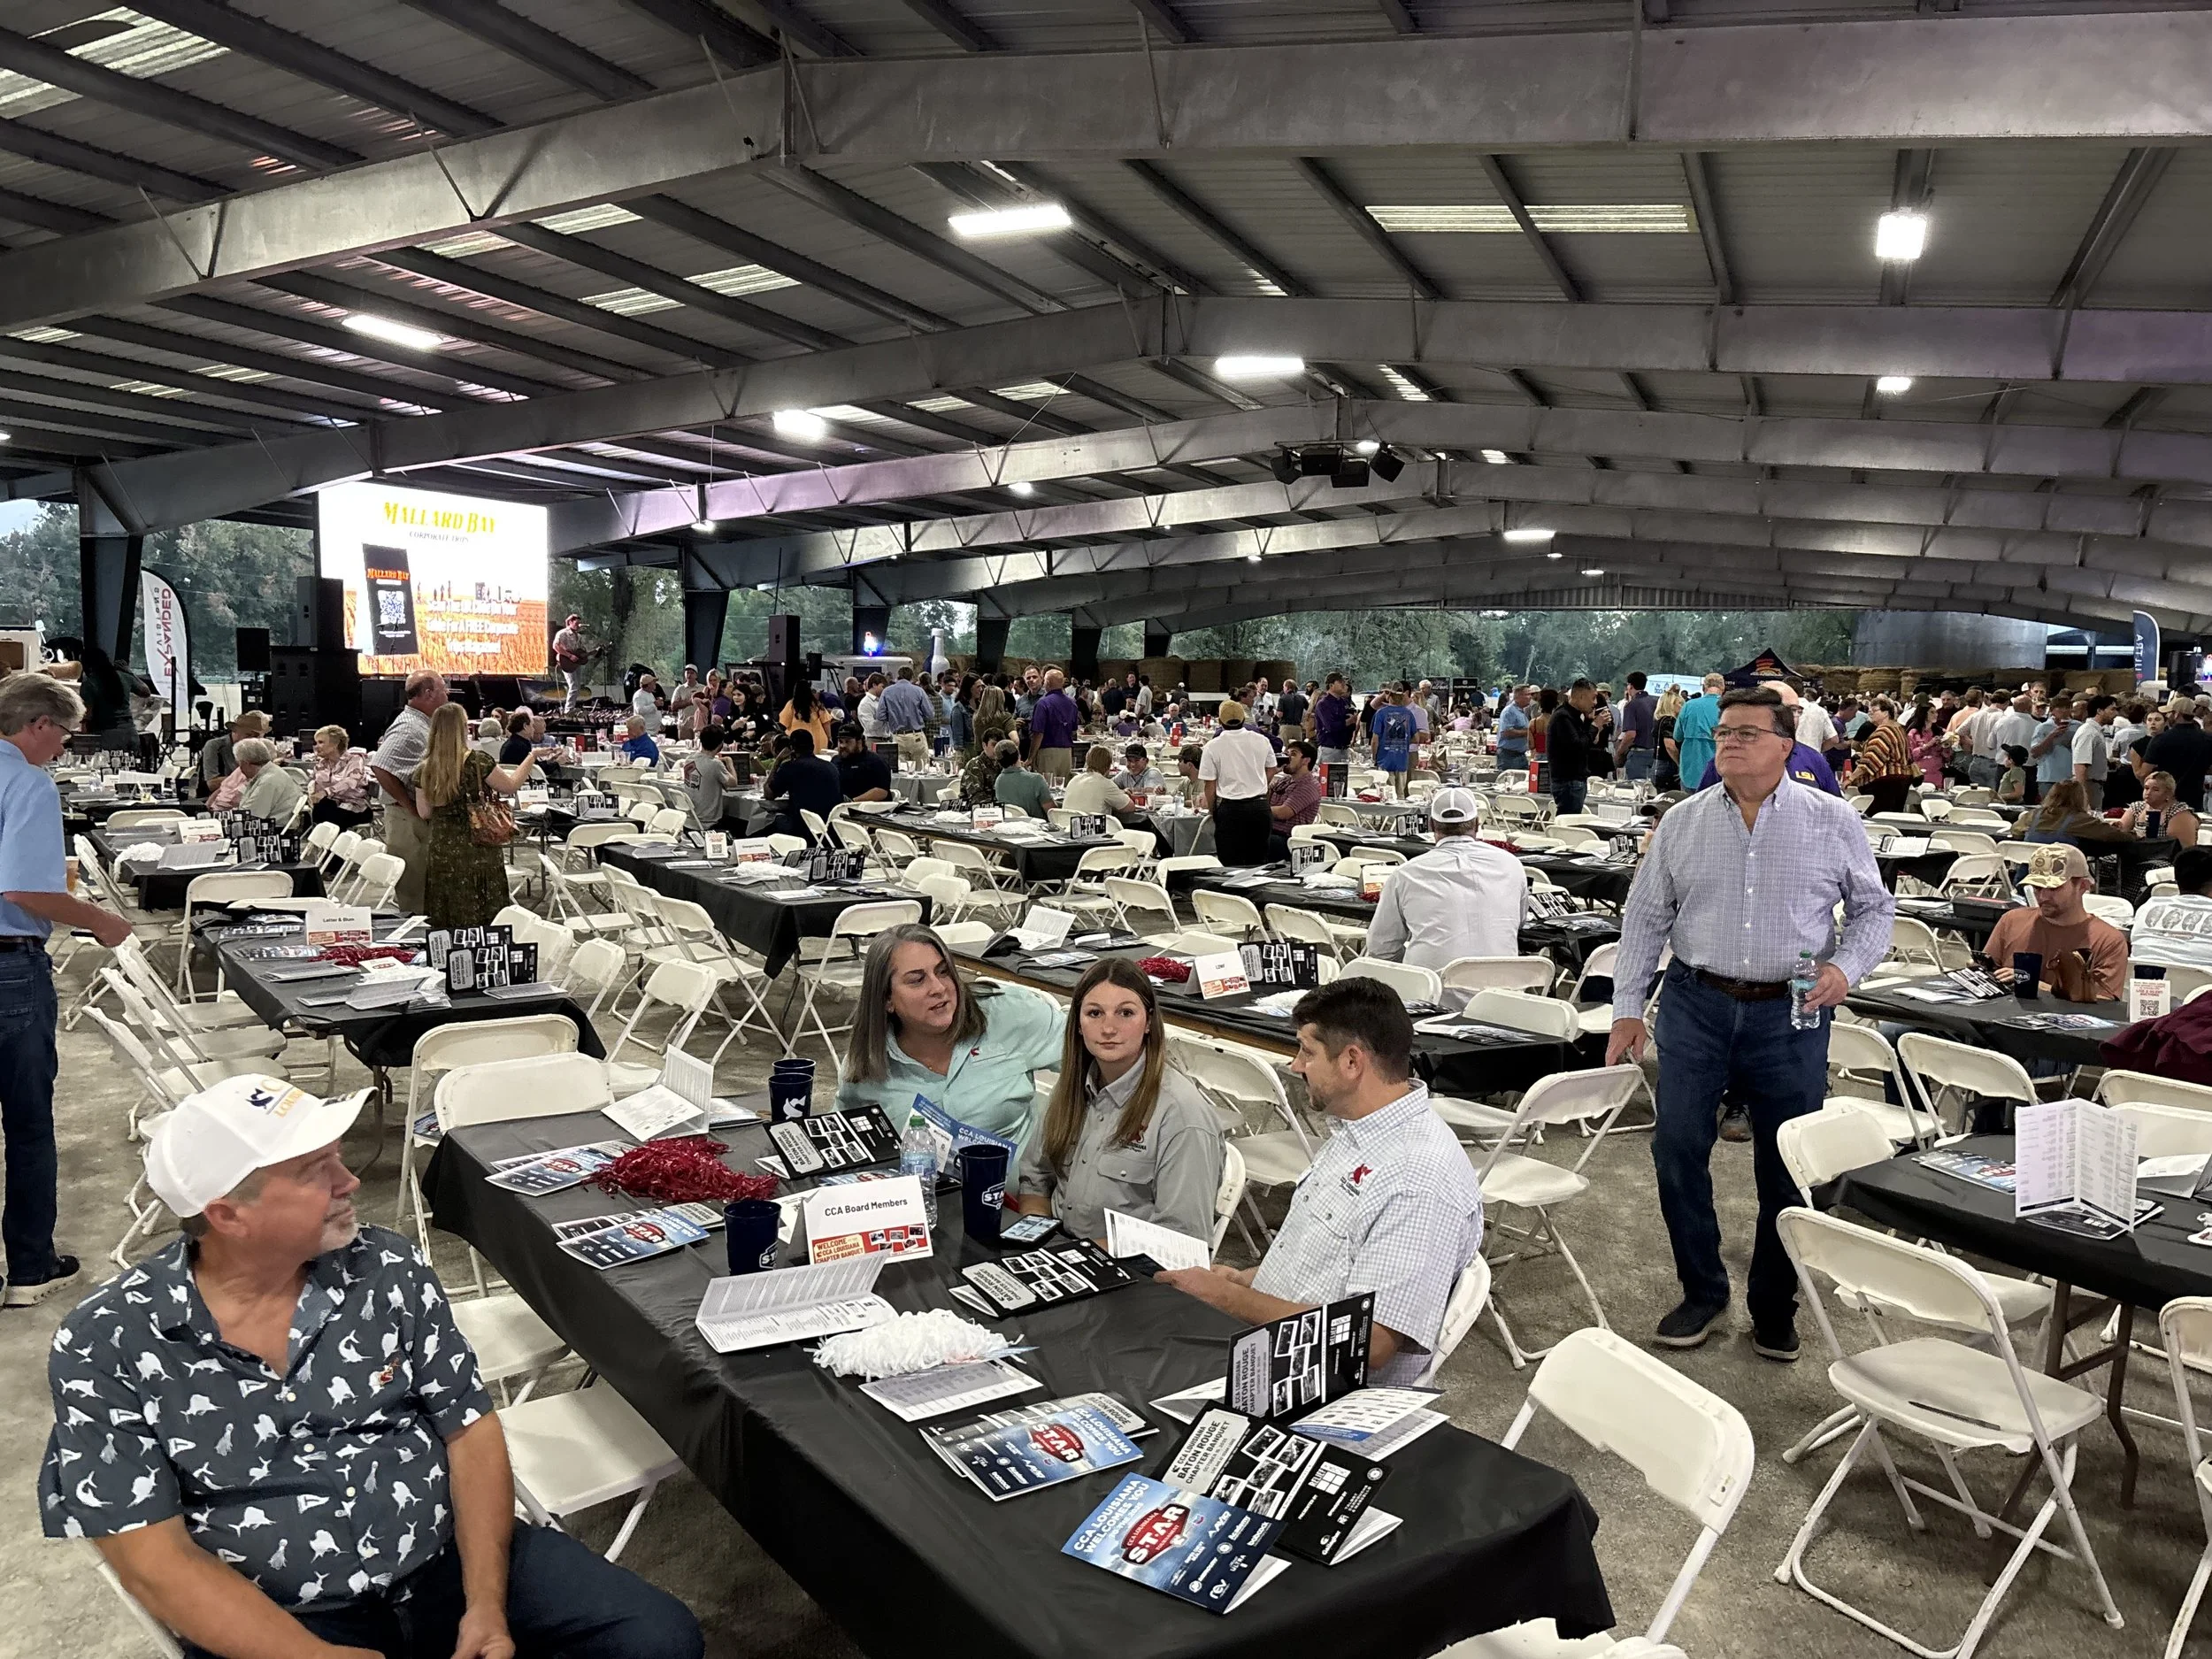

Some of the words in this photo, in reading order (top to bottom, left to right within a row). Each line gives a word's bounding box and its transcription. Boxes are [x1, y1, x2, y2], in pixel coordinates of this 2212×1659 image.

[383, 502, 464, 529] MALLARD
[466, 512, 495, 533] BAY
[409, 531, 449, 542] CORPORATE
[367, 568, 397, 579] MALLARD
[398, 570, 411, 580] BAY
[1795, 771, 1816, 781] LSU
[958, 1127, 974, 1138] CCA
[825, 1207, 844, 1217] CCA
[844, 1203, 870, 1214] Board
[871, 1198, 908, 1210] Members
[815, 1253, 841, 1263] CHAPTER
[841, 1247, 864, 1259] BANQUET
[817, 1238, 848, 1251] WELCOME
[833, 1242, 860, 1255] LOUISIANA
[1103, 1408, 1133, 1425] ROUGE
[1067, 1409, 1106, 1441] WELCOMES
[1102, 1440, 1123, 1456] YOU
[1074, 1407, 1093, 1418] CCA
[1088, 1417, 1133, 1454] LOUISIANA
[1177, 1452, 1189, 1464] CCA
[1184, 1425, 1206, 1453] LOUISIANA
[1177, 1449, 1201, 1479] BATON
[1196, 1420, 1220, 1449] ROUGE
[1185, 1451, 1210, 1484] CHAPTER
[1206, 1420, 1230, 1452] BANQUET
[1308, 1468, 1325, 1486] RELIEF
[1071, 1527, 1097, 1550] CCA
[1090, 1479, 1141, 1528] LOUISIANA
[1082, 1502, 1133, 1553] WELCOMES
[1127, 1482, 1149, 1501] YOU
[1227, 1514, 1253, 1540] Academy
[1125, 1534, 1138, 1546] CCA
[1132, 1510, 1158, 1536] LOUISIANA
[1155, 1524, 1179, 1550] TOURNAMENT
[1246, 1520, 1270, 1546] babcock
[1320, 1530, 1341, 1555] Gallagher
[1229, 1553, 1246, 1571] ULTRA
[1208, 1578, 1229, 1598] rev
